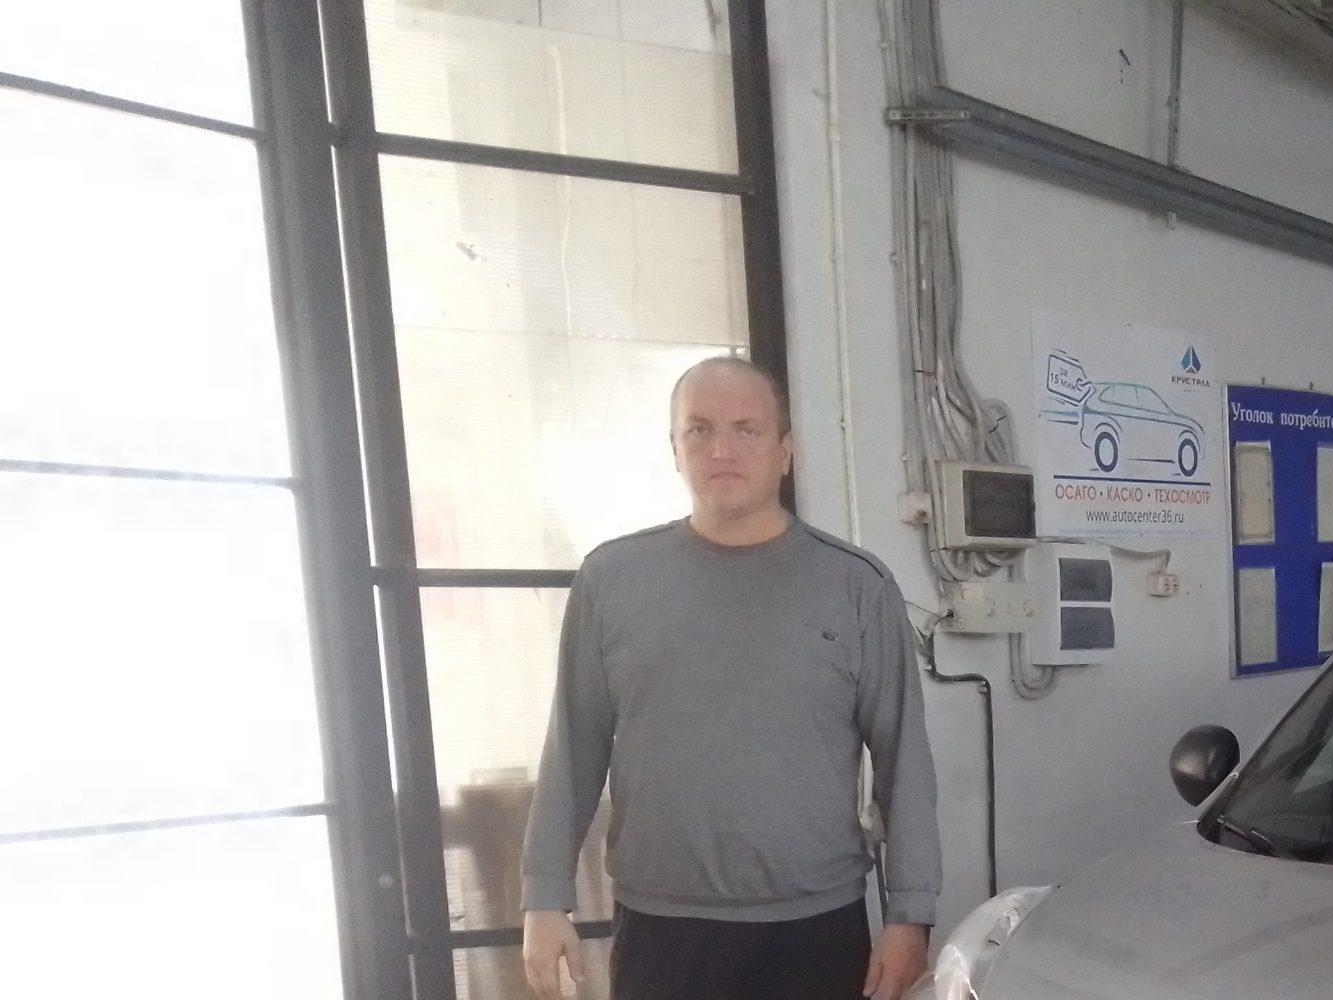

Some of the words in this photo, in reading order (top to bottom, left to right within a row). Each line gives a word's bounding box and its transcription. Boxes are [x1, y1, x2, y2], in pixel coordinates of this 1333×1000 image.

[1050, 372, 1059, 384] 15
[1231, 402, 1274, 424] Уголок
[1055, 484, 1097, 500] ОСАГО
[1107, 486, 1143, 502] КАСКО
[1155, 488, 1211, 504] ТЕХОСМОТР
[1086, 509, 1184, 524] www.autocenter36.ru
